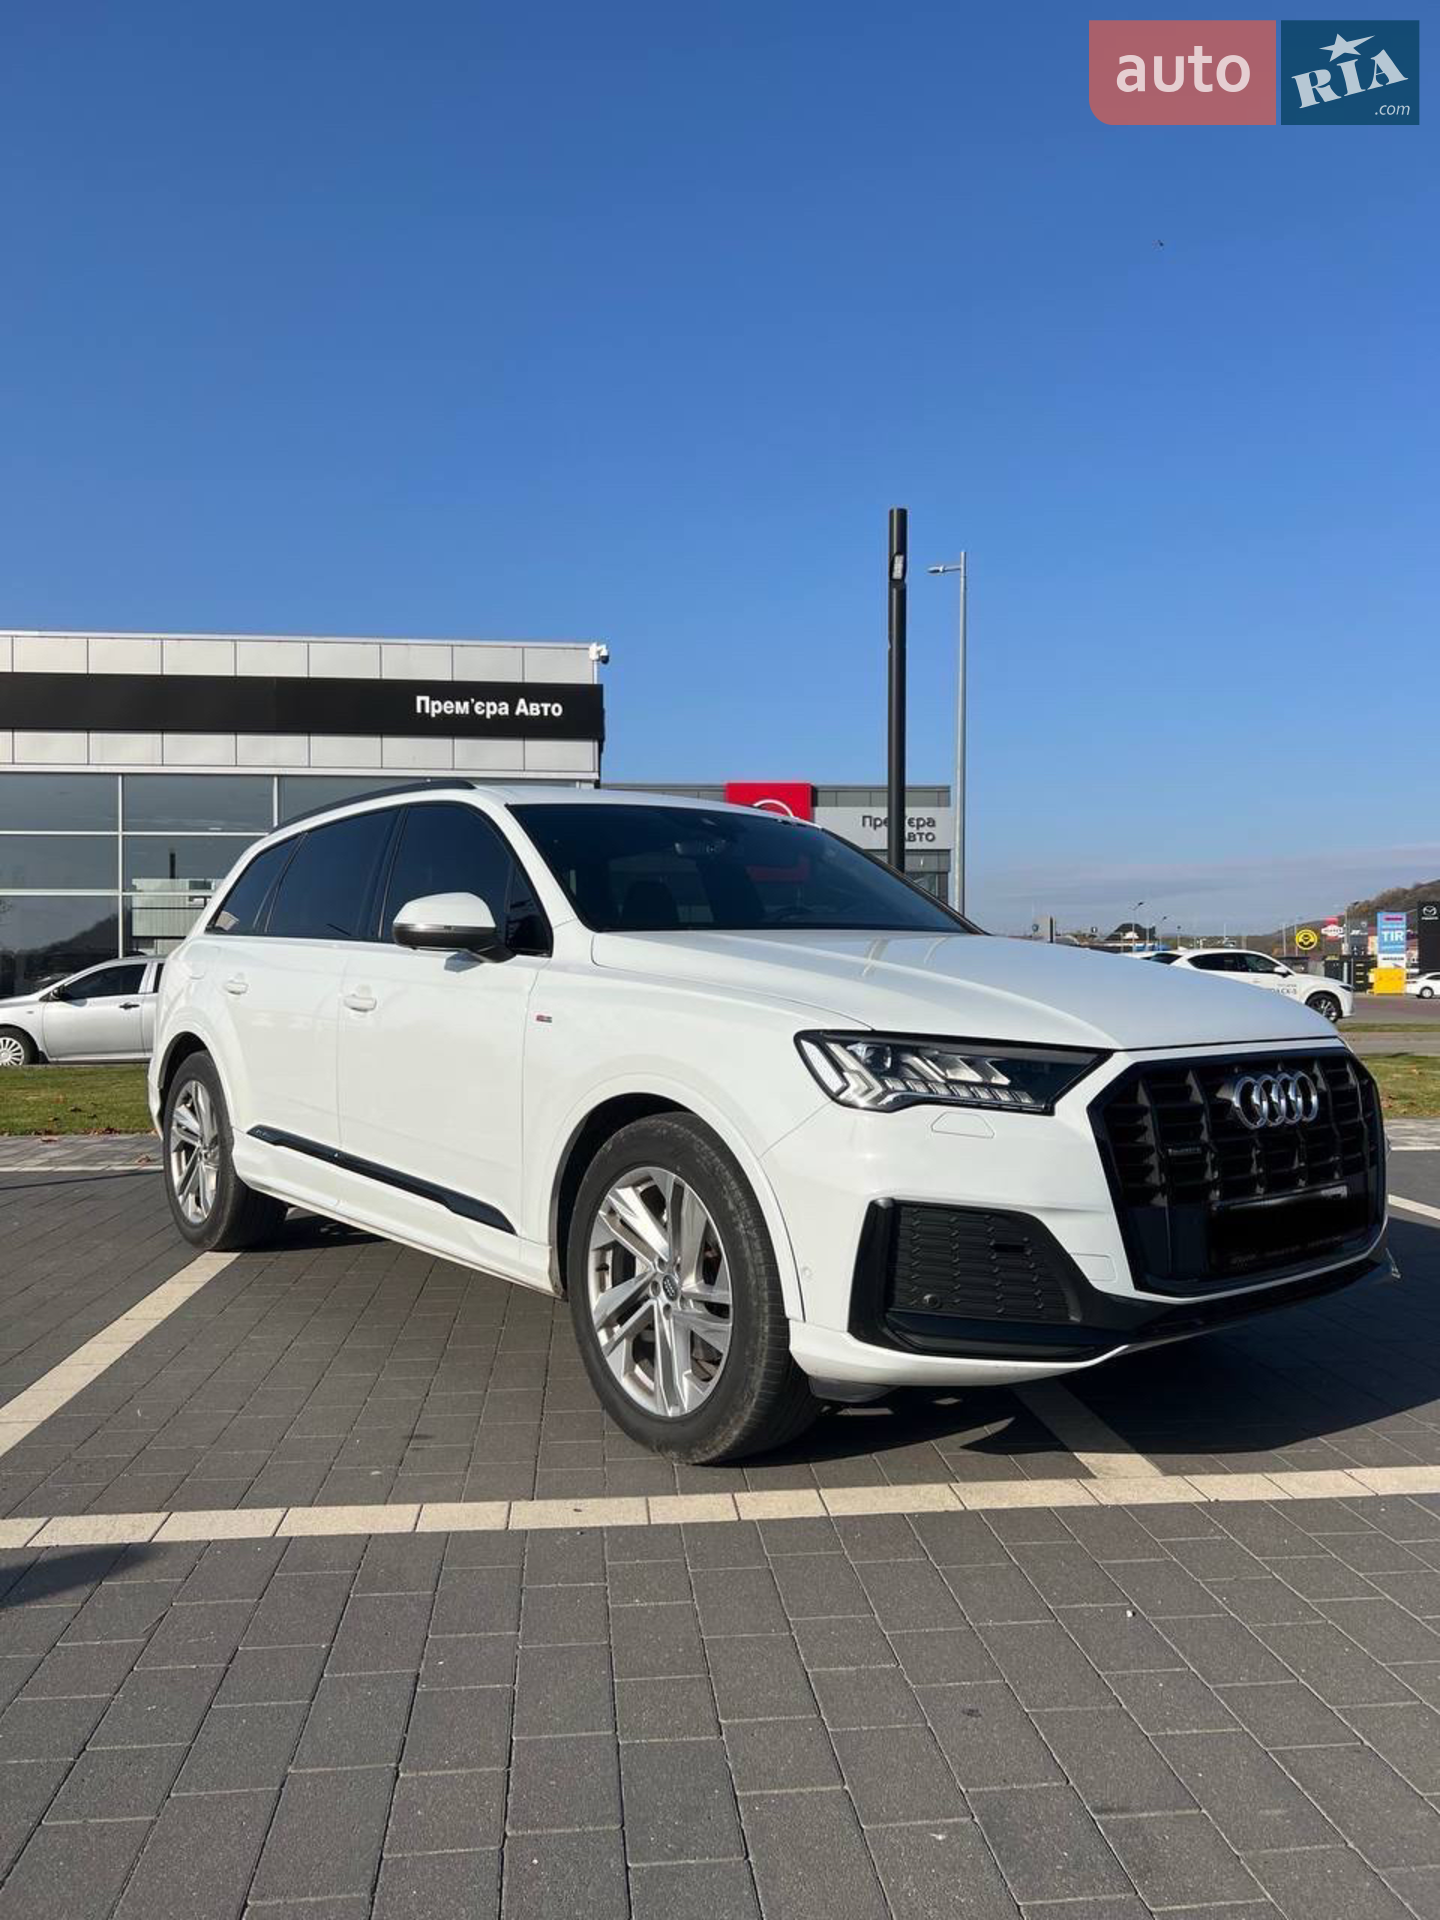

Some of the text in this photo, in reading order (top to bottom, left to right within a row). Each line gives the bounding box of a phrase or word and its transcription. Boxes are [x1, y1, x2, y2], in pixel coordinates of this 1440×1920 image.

[416, 695, 563, 719] Прем'єра Авто
[862, 815, 936, 831] Преєра
[904, 832, 936, 842] вто
[1381, 930, 1404, 942] TIR
